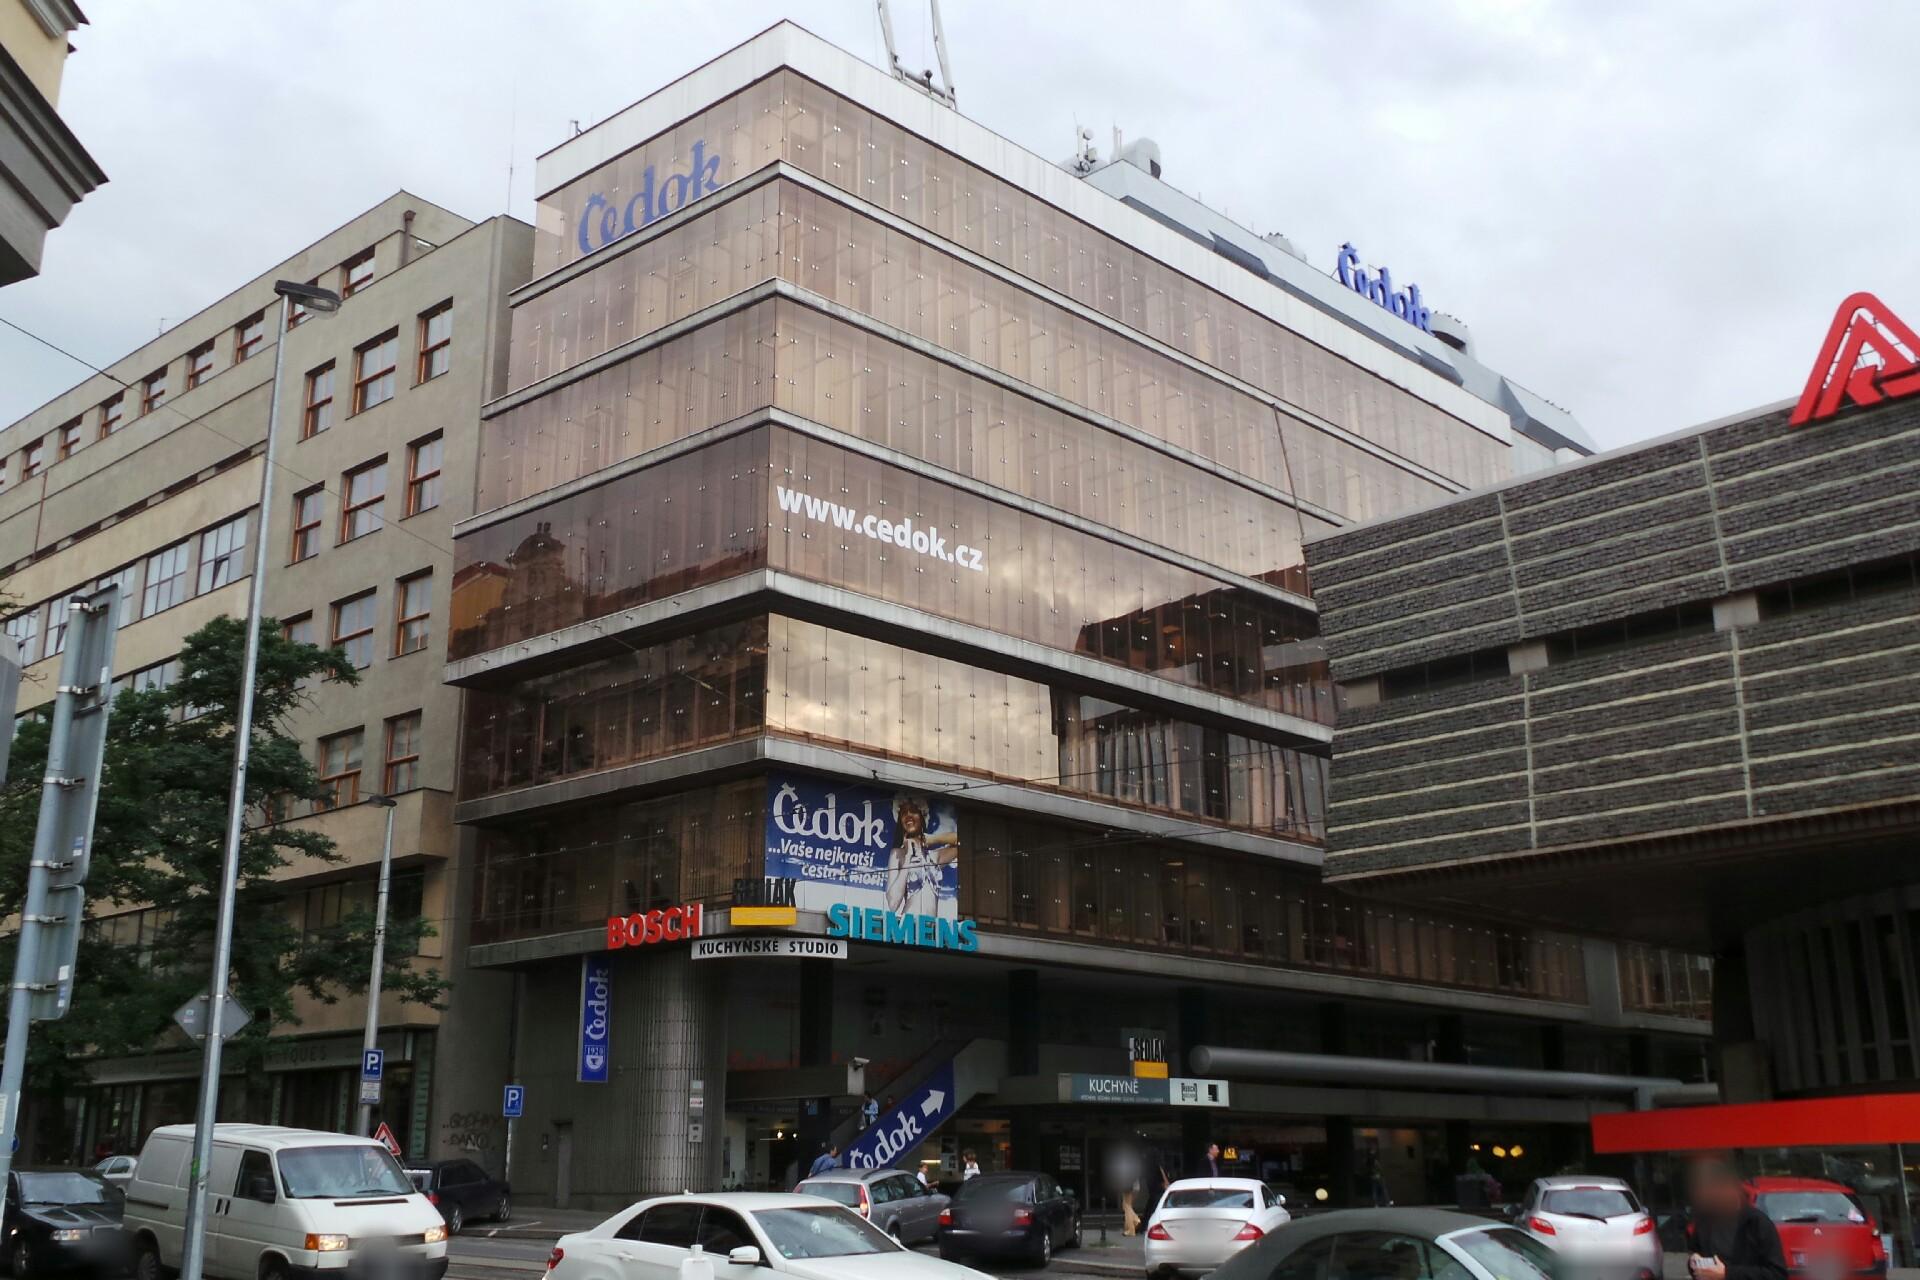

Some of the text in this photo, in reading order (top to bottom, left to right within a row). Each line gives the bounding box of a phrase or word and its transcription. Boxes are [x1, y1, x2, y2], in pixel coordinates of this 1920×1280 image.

[578, 139, 725, 255] Čedok
[1337, 241, 1437, 338] Čedok
[776, 485, 985, 572] www.cedok.cz
[772, 782, 888, 849] Čedok
[815, 846, 875, 868] nejkratší
[607, 902, 703, 950] BOSCH
[789, 940, 839, 956] STUDIO
[827, 902, 978, 952] SIEMENS
[585, 967, 608, 1040] Čedok
[366, 1053, 379, 1071] P
[507, 1089, 520, 1108] P
[850, 1111, 922, 1169] Čedok
